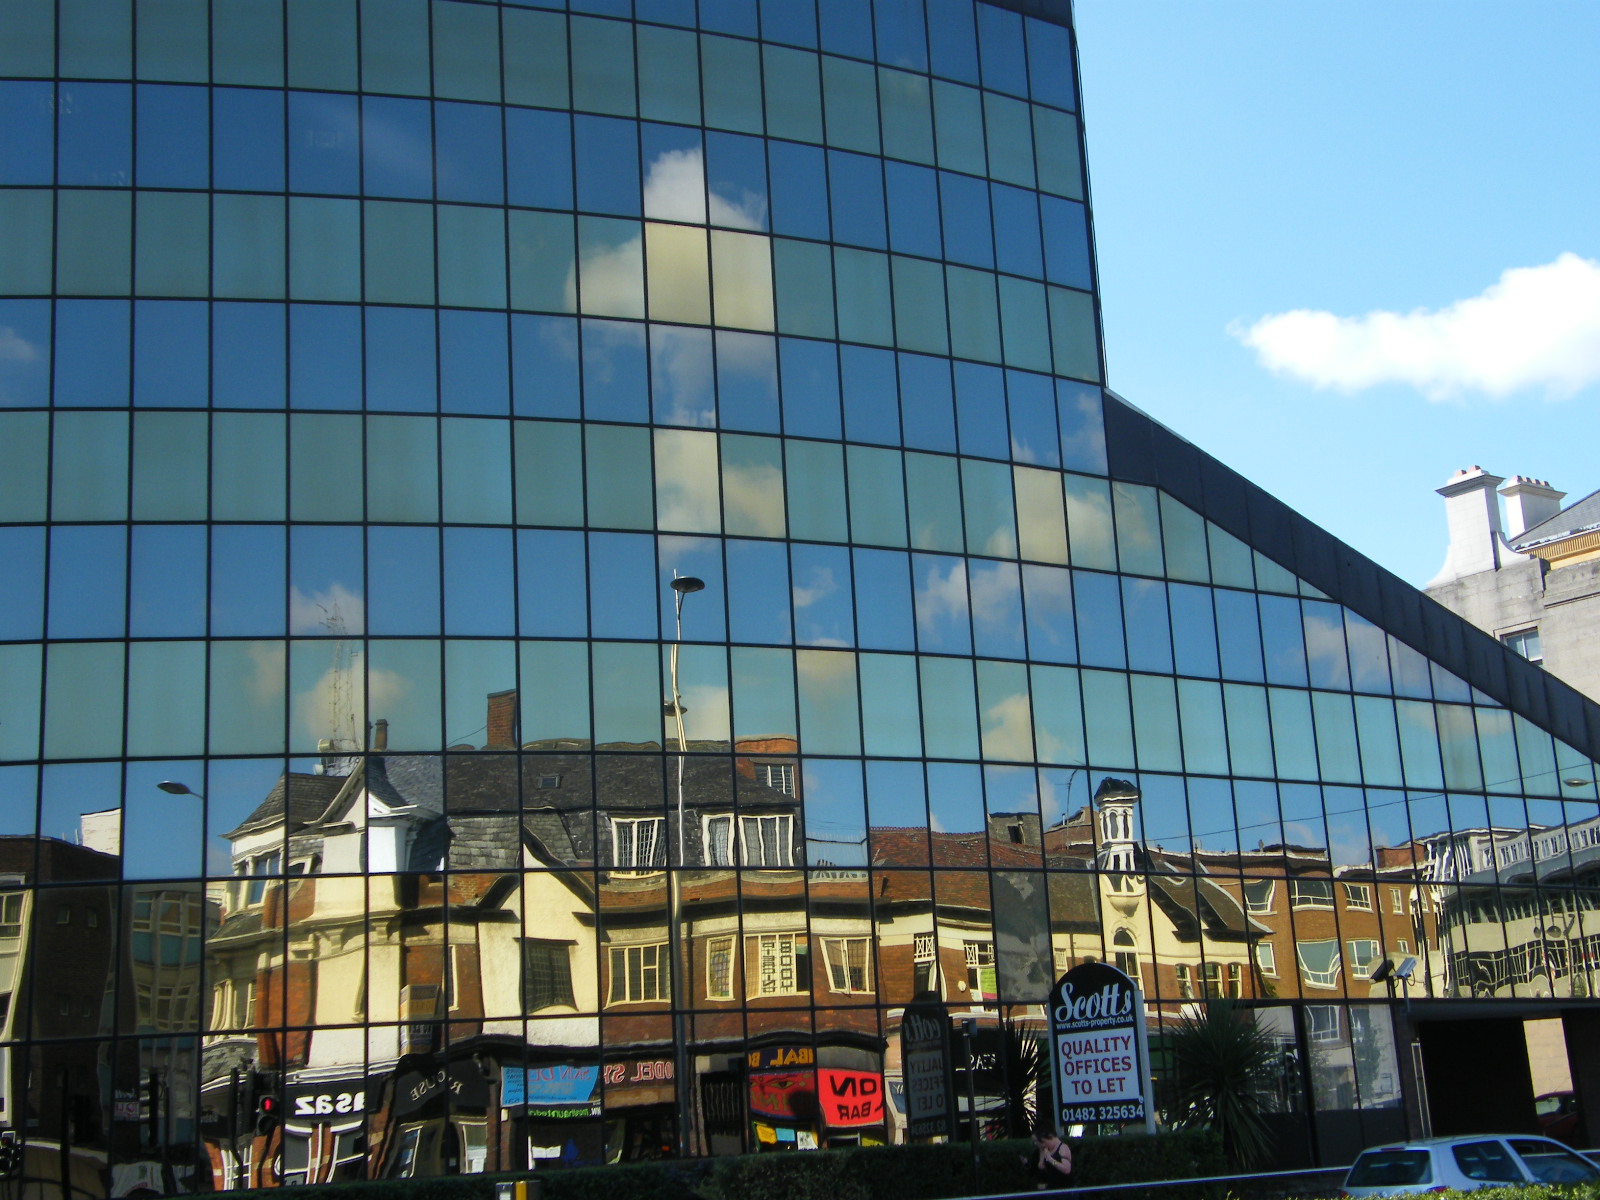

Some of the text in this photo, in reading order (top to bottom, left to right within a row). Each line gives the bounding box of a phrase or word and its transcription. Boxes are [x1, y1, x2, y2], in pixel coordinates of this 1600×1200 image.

[1055, 982, 1132, 1022] Scotts
[1056, 1014, 1134, 1030] www.scotts-property.co.uk
[1061, 1035, 1131, 1059] QUALITY
[1064, 1056, 1132, 1076] OFFICES
[1071, 1077, 1126, 1095] TO LET
[1062, 1104, 1144, 1122] 01482 325634
